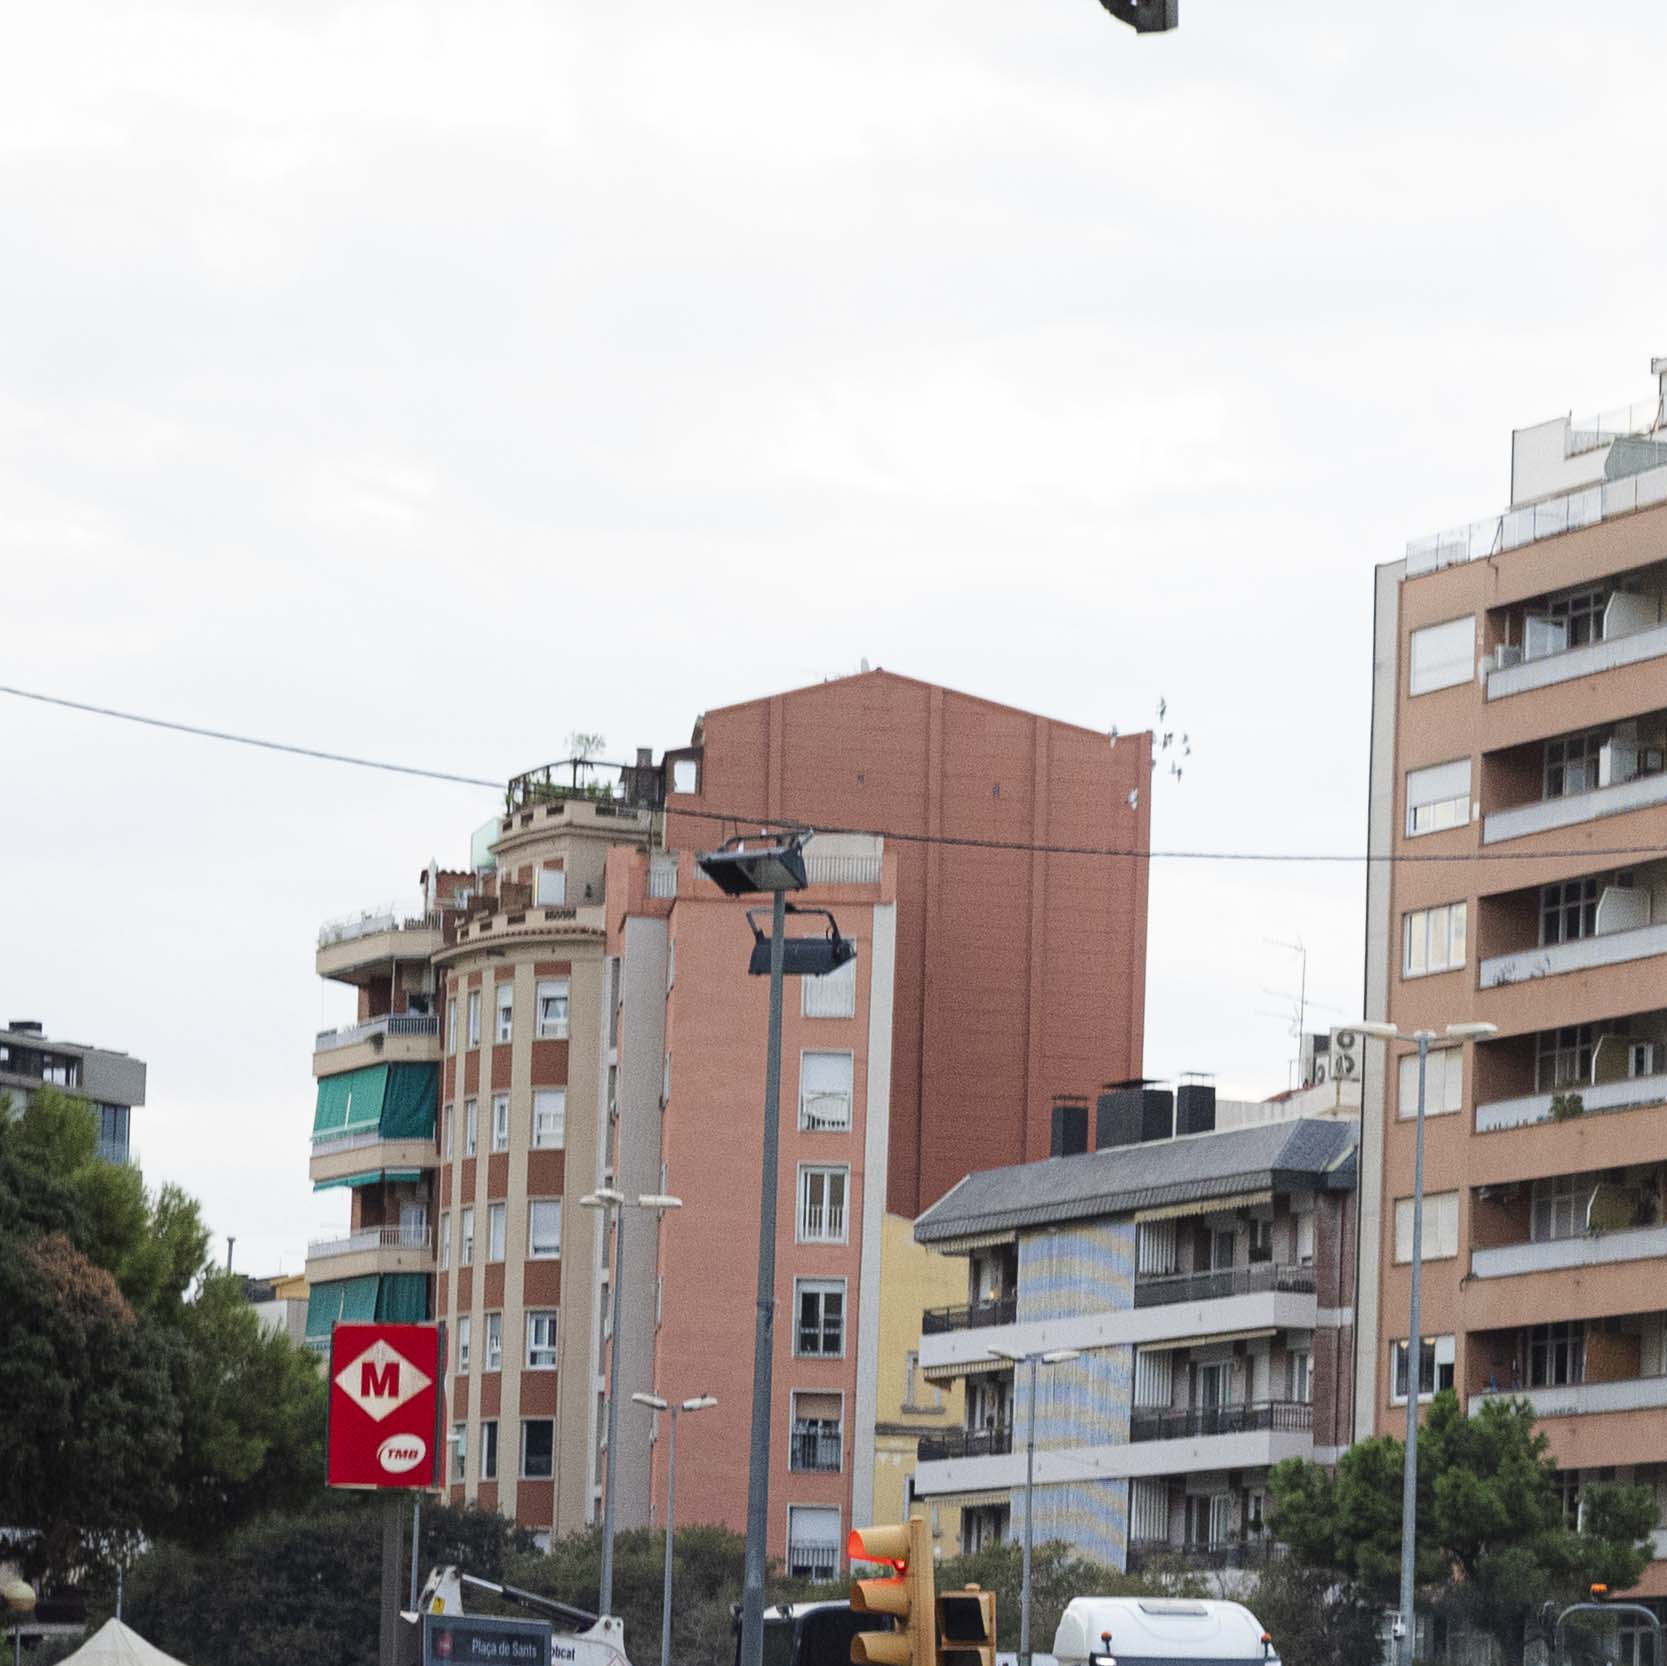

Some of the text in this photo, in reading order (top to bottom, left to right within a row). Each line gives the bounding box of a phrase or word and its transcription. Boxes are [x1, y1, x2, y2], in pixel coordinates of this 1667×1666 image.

[361, 1362, 400, 1398] M
[387, 1449, 418, 1461] TMB
[472, 1638, 537, 1659] Plaça de Sants
